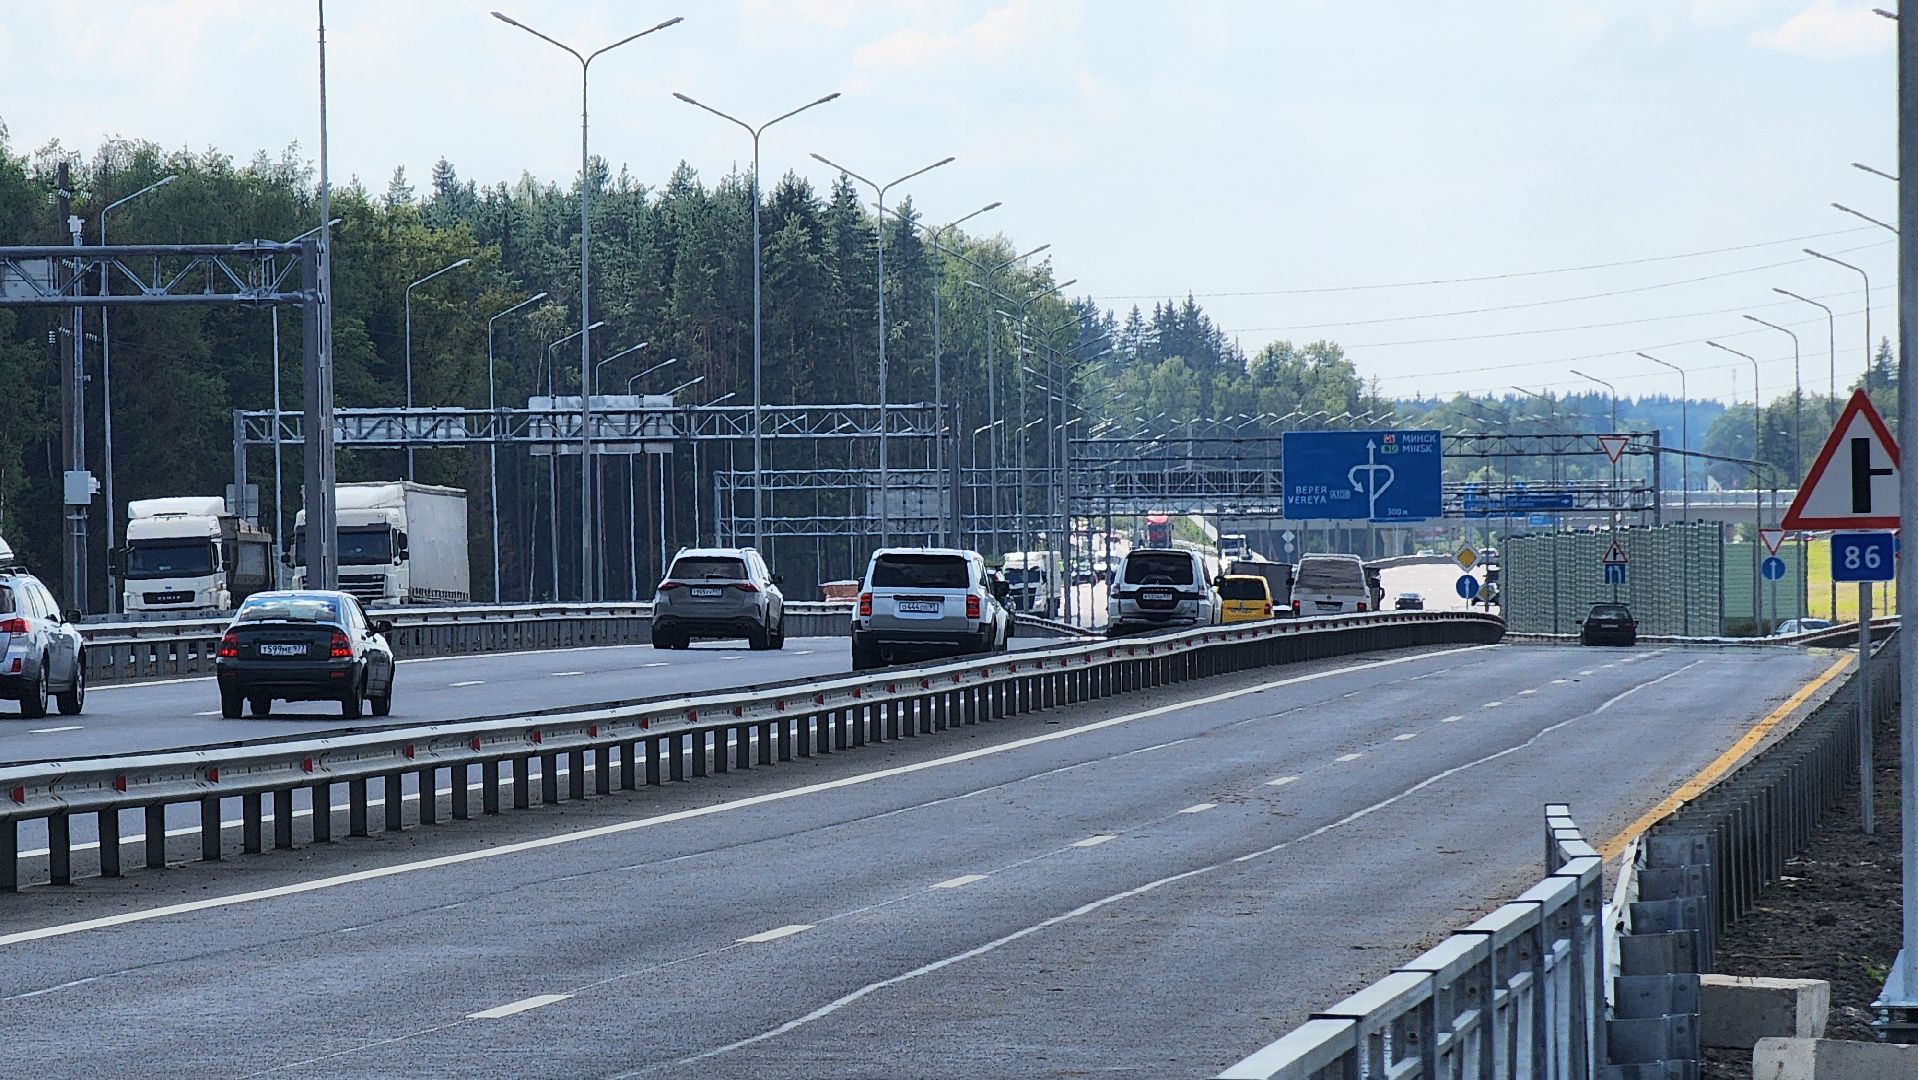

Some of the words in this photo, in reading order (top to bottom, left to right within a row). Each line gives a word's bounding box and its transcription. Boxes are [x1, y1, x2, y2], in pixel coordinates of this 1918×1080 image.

[1402, 434, 1436, 443] МИНСК
[1402, 444, 1432, 453] MINSK
[1295, 485, 1327, 494] ВЕРЕЯ
[1287, 495, 1327, 504] VEREYA
[1387, 507, 1401, 516] 300
[1844, 545, 1881, 569] 86
